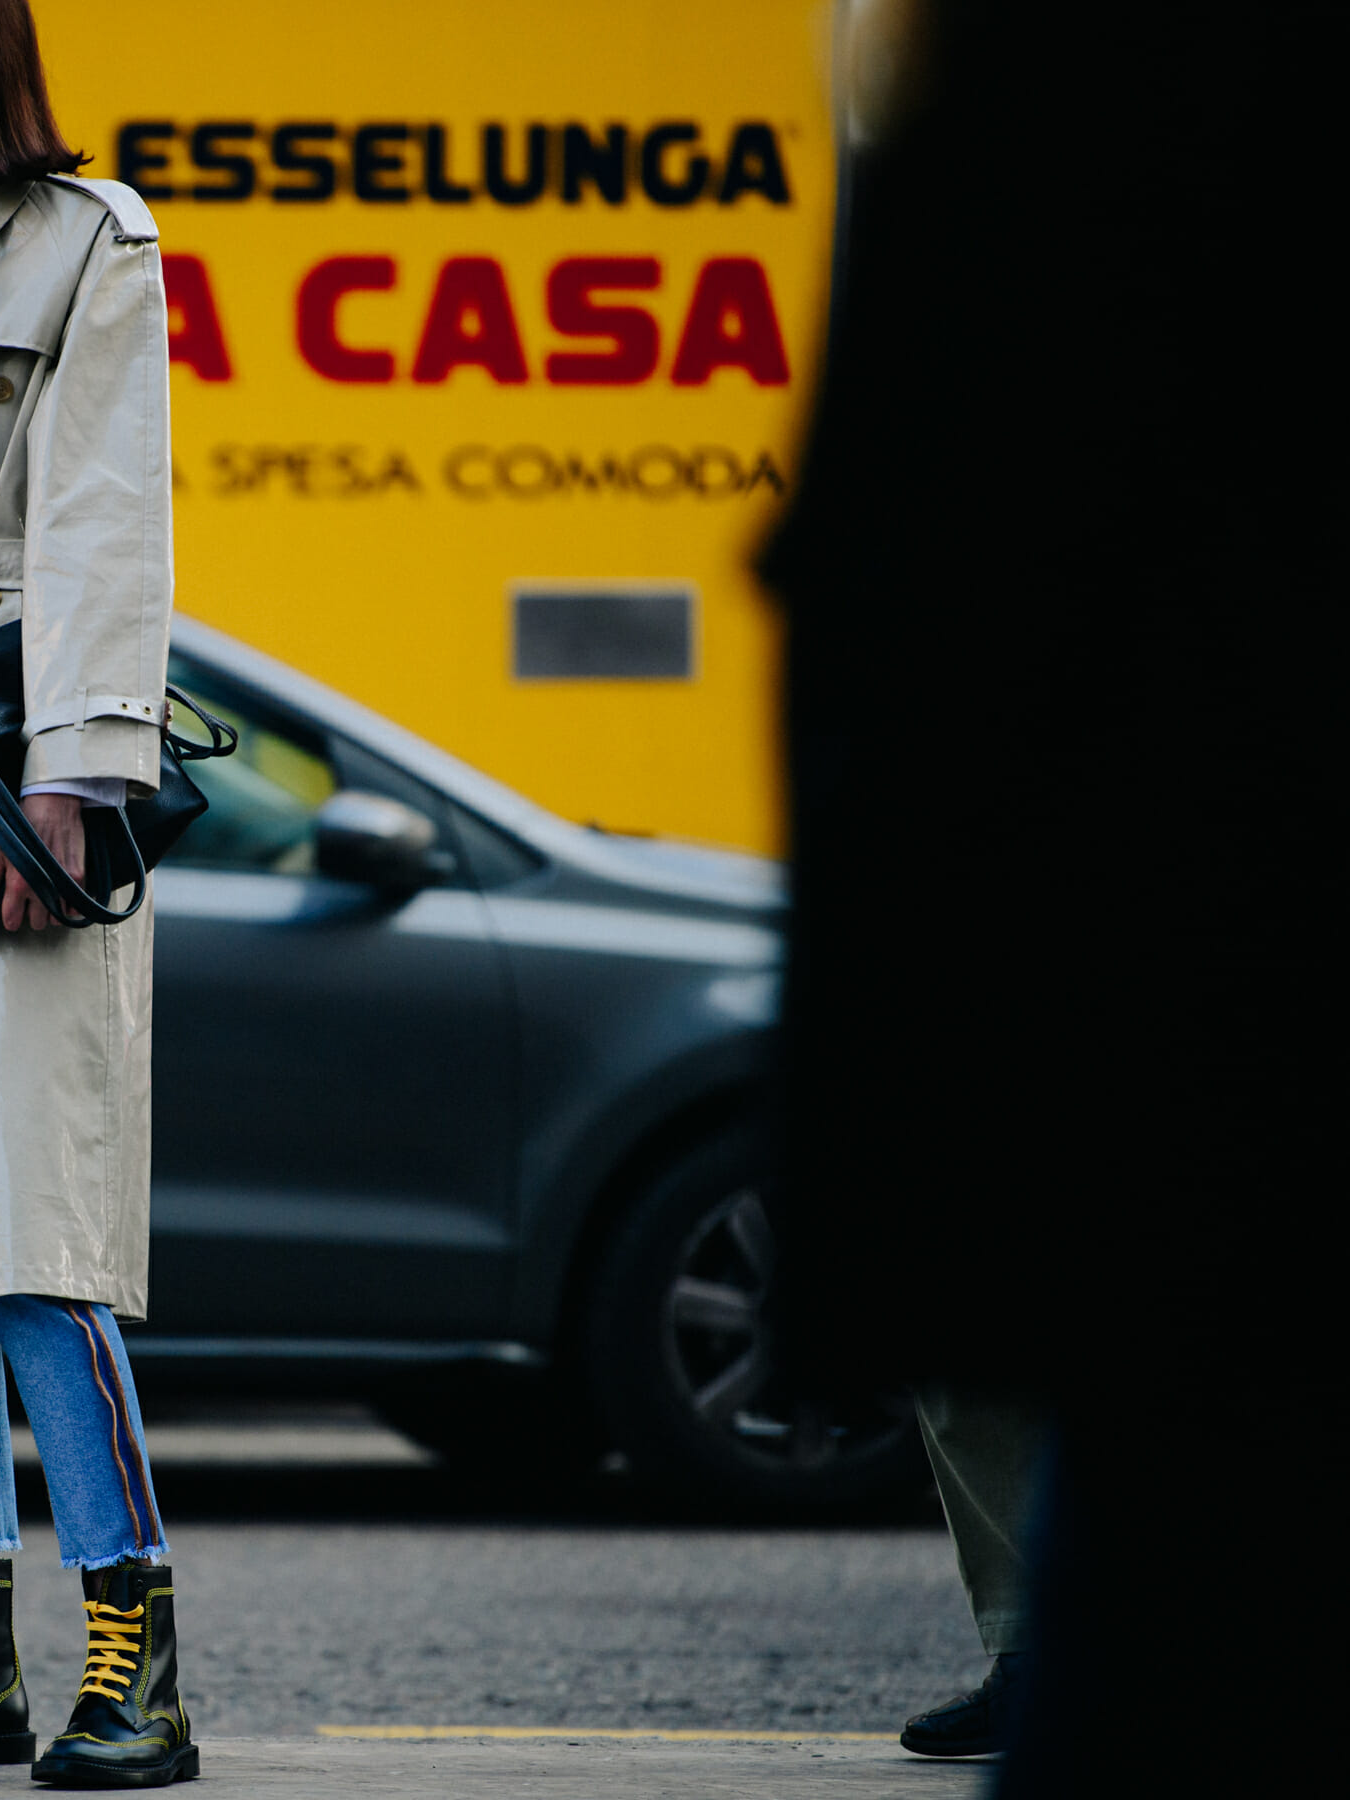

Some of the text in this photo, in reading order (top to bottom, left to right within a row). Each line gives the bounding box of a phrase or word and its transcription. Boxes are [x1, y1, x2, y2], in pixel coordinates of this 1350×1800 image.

[115, 119, 794, 206] ESSELUNGA
[294, 255, 791, 386] CASA
[208, 443, 424, 498] SPESA
[441, 442, 786, 502] COMODA
